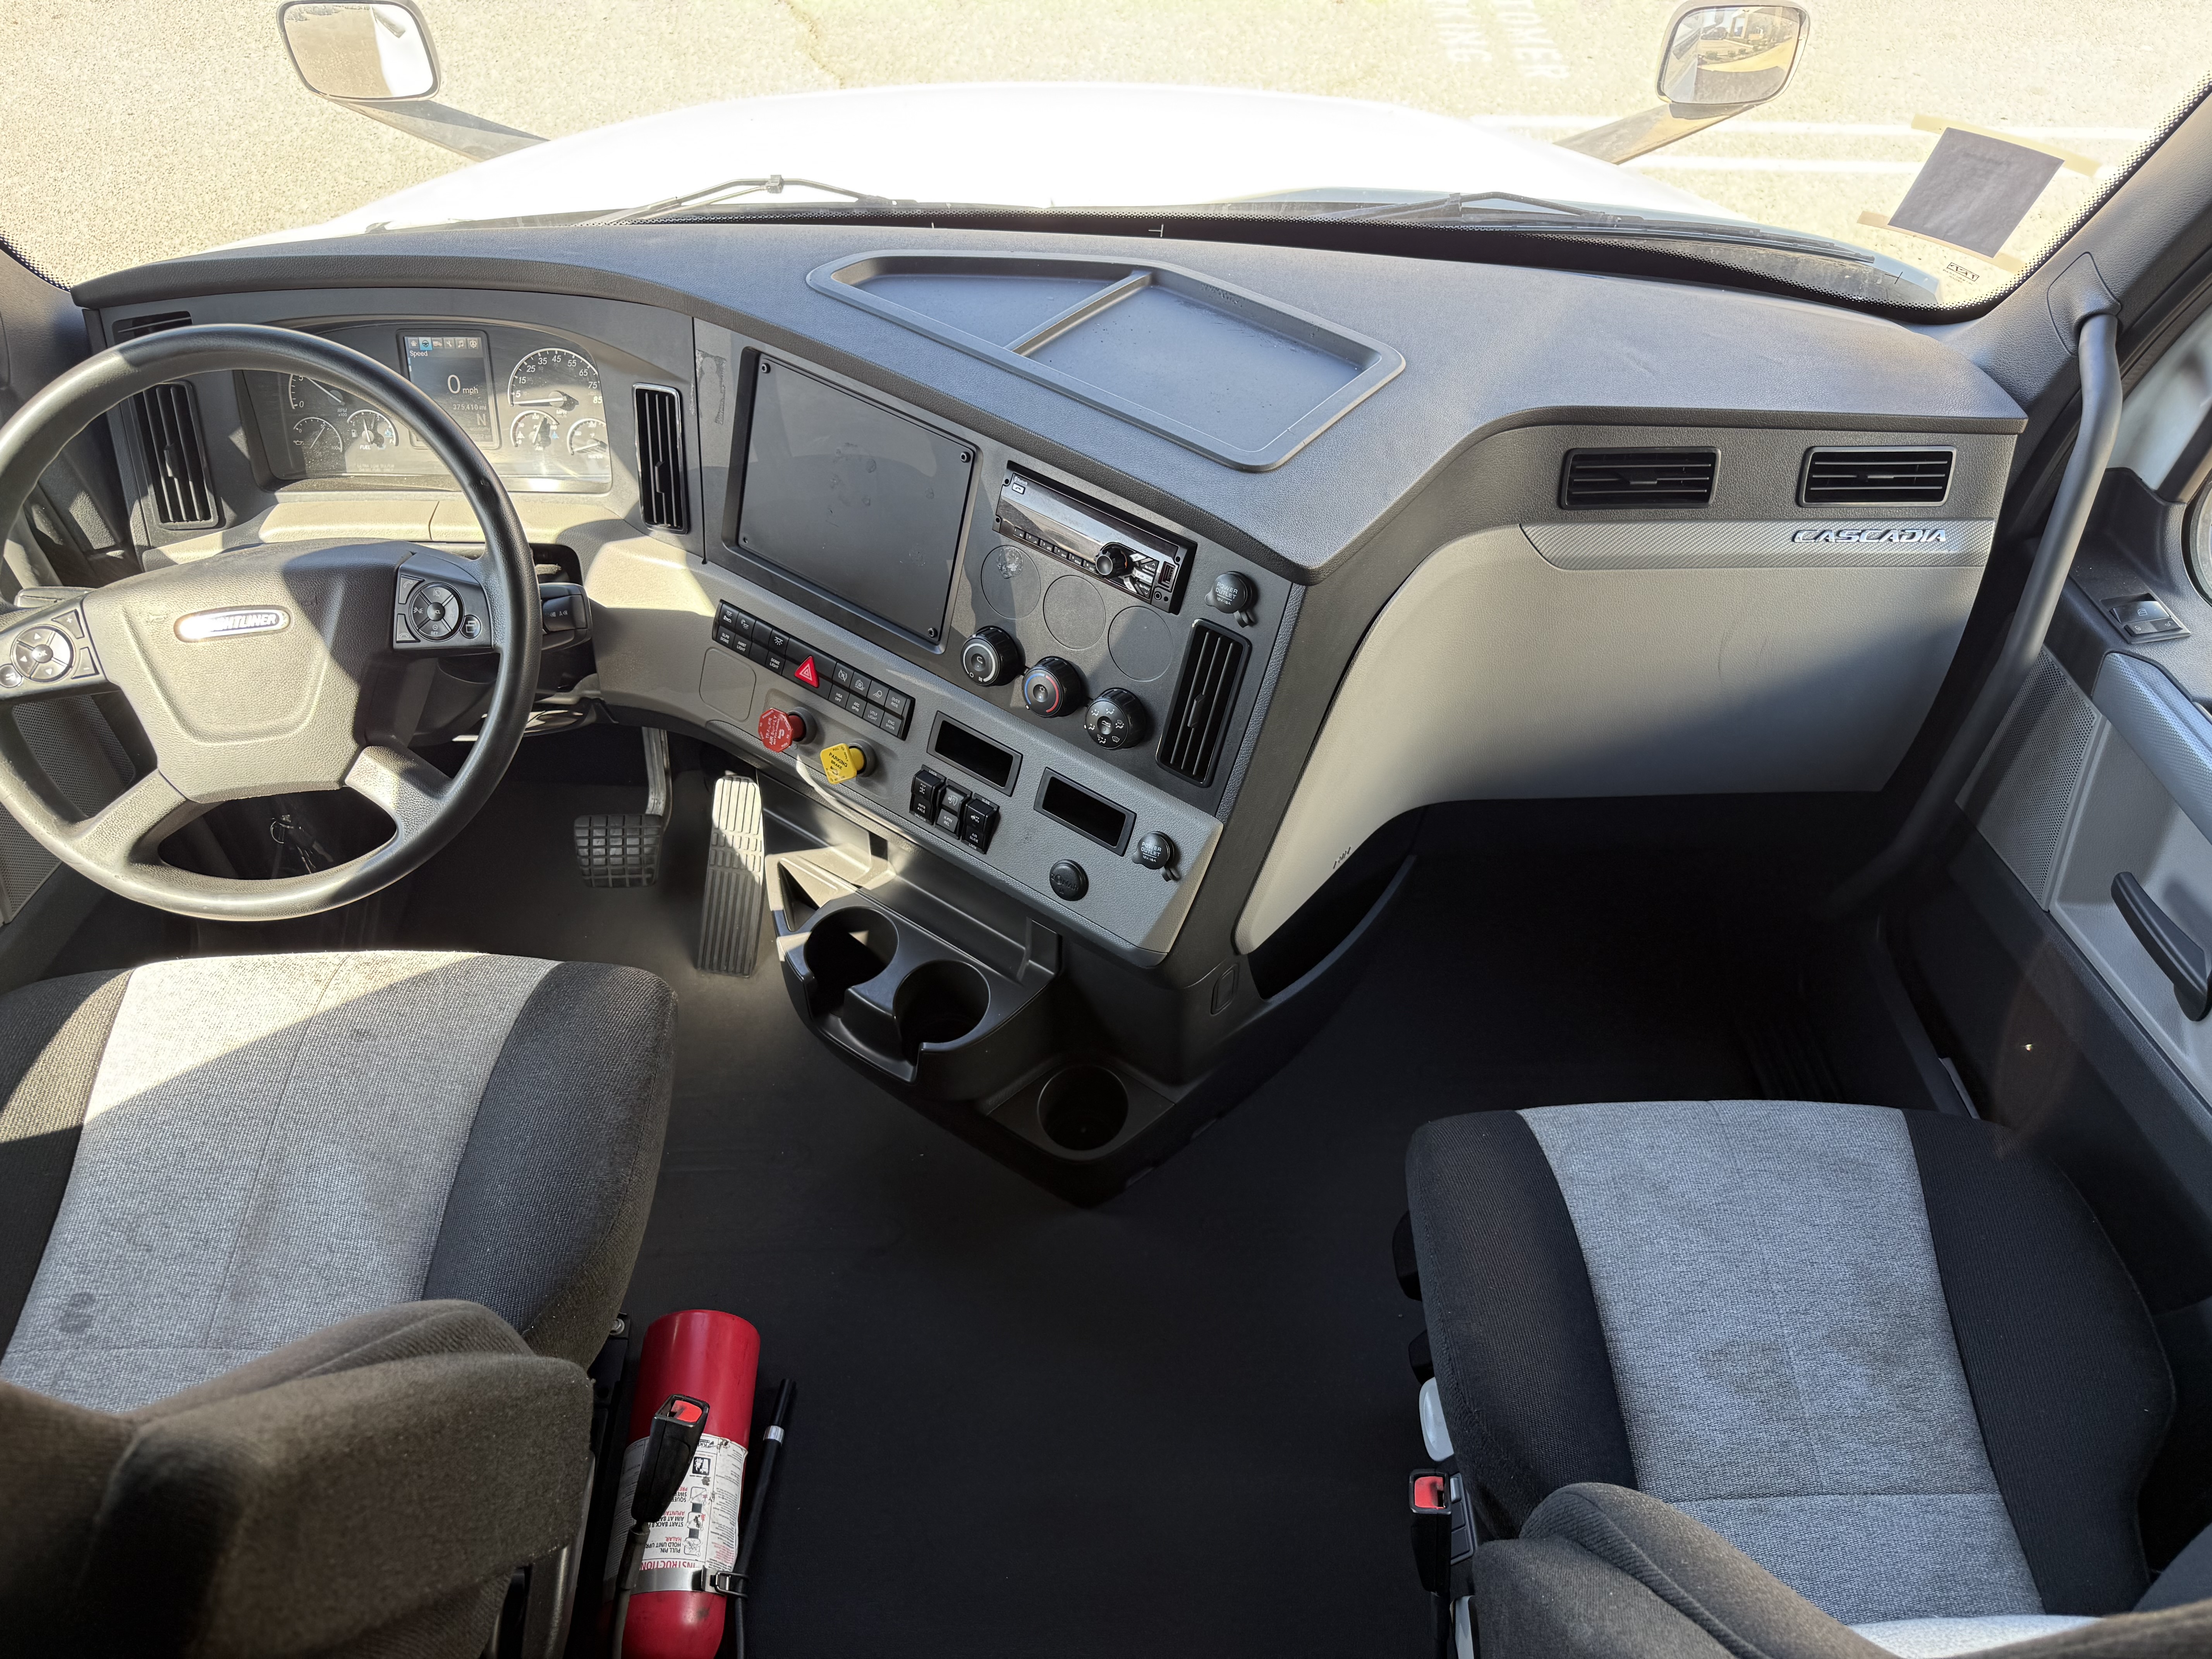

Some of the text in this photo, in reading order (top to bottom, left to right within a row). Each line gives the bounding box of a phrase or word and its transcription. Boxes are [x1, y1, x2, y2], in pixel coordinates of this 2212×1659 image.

[447, 374, 460, 394] 0
[476, 413, 486, 426] N
[1793, 529, 1946, 542] CASCADIA
[1215, 587, 1237, 599] OUTLET
[1217, 582, 1238, 594] POWER
[829, 752, 848, 767] PARKING
[831, 760, 843, 770] BRAKE
[1140, 847, 1161, 857] OUTLET
[1142, 841, 1162, 852] POWER
